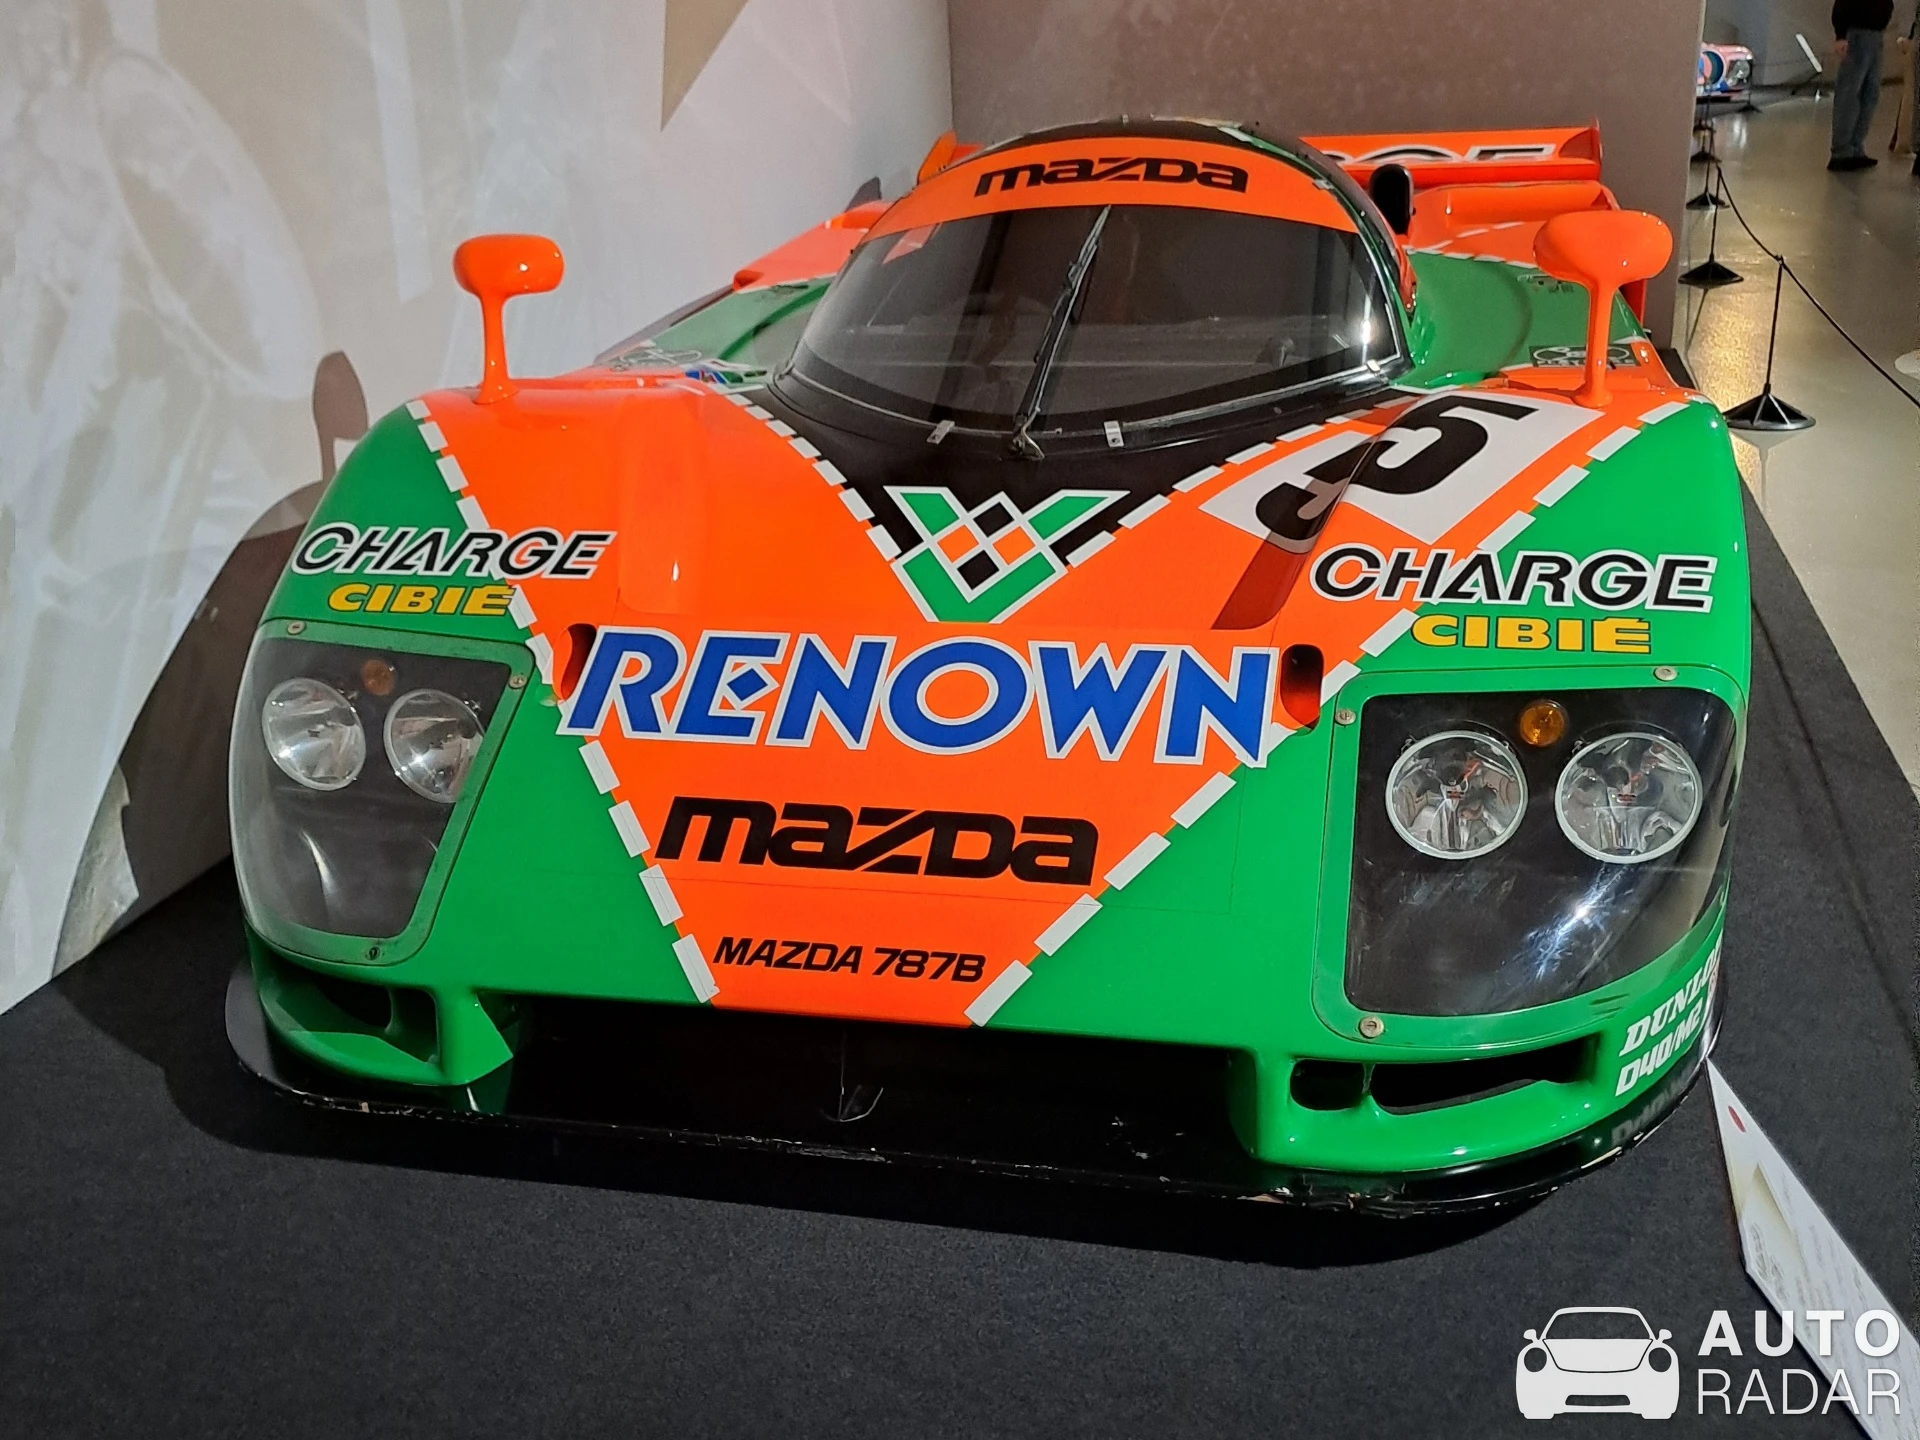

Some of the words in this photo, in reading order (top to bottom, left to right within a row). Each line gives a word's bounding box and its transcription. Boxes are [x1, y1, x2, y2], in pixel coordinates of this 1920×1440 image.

[291, 522, 617, 580] CHARGE
[327, 582, 517, 616] CIBIÉ
[1309, 542, 1718, 614] CHARGE
[1410, 614, 1652, 655] CIBIÉ
[556, 625, 1280, 769] RENOWN
[713, 936, 863, 974] MAZDA
[872, 947, 987, 983] 787B
